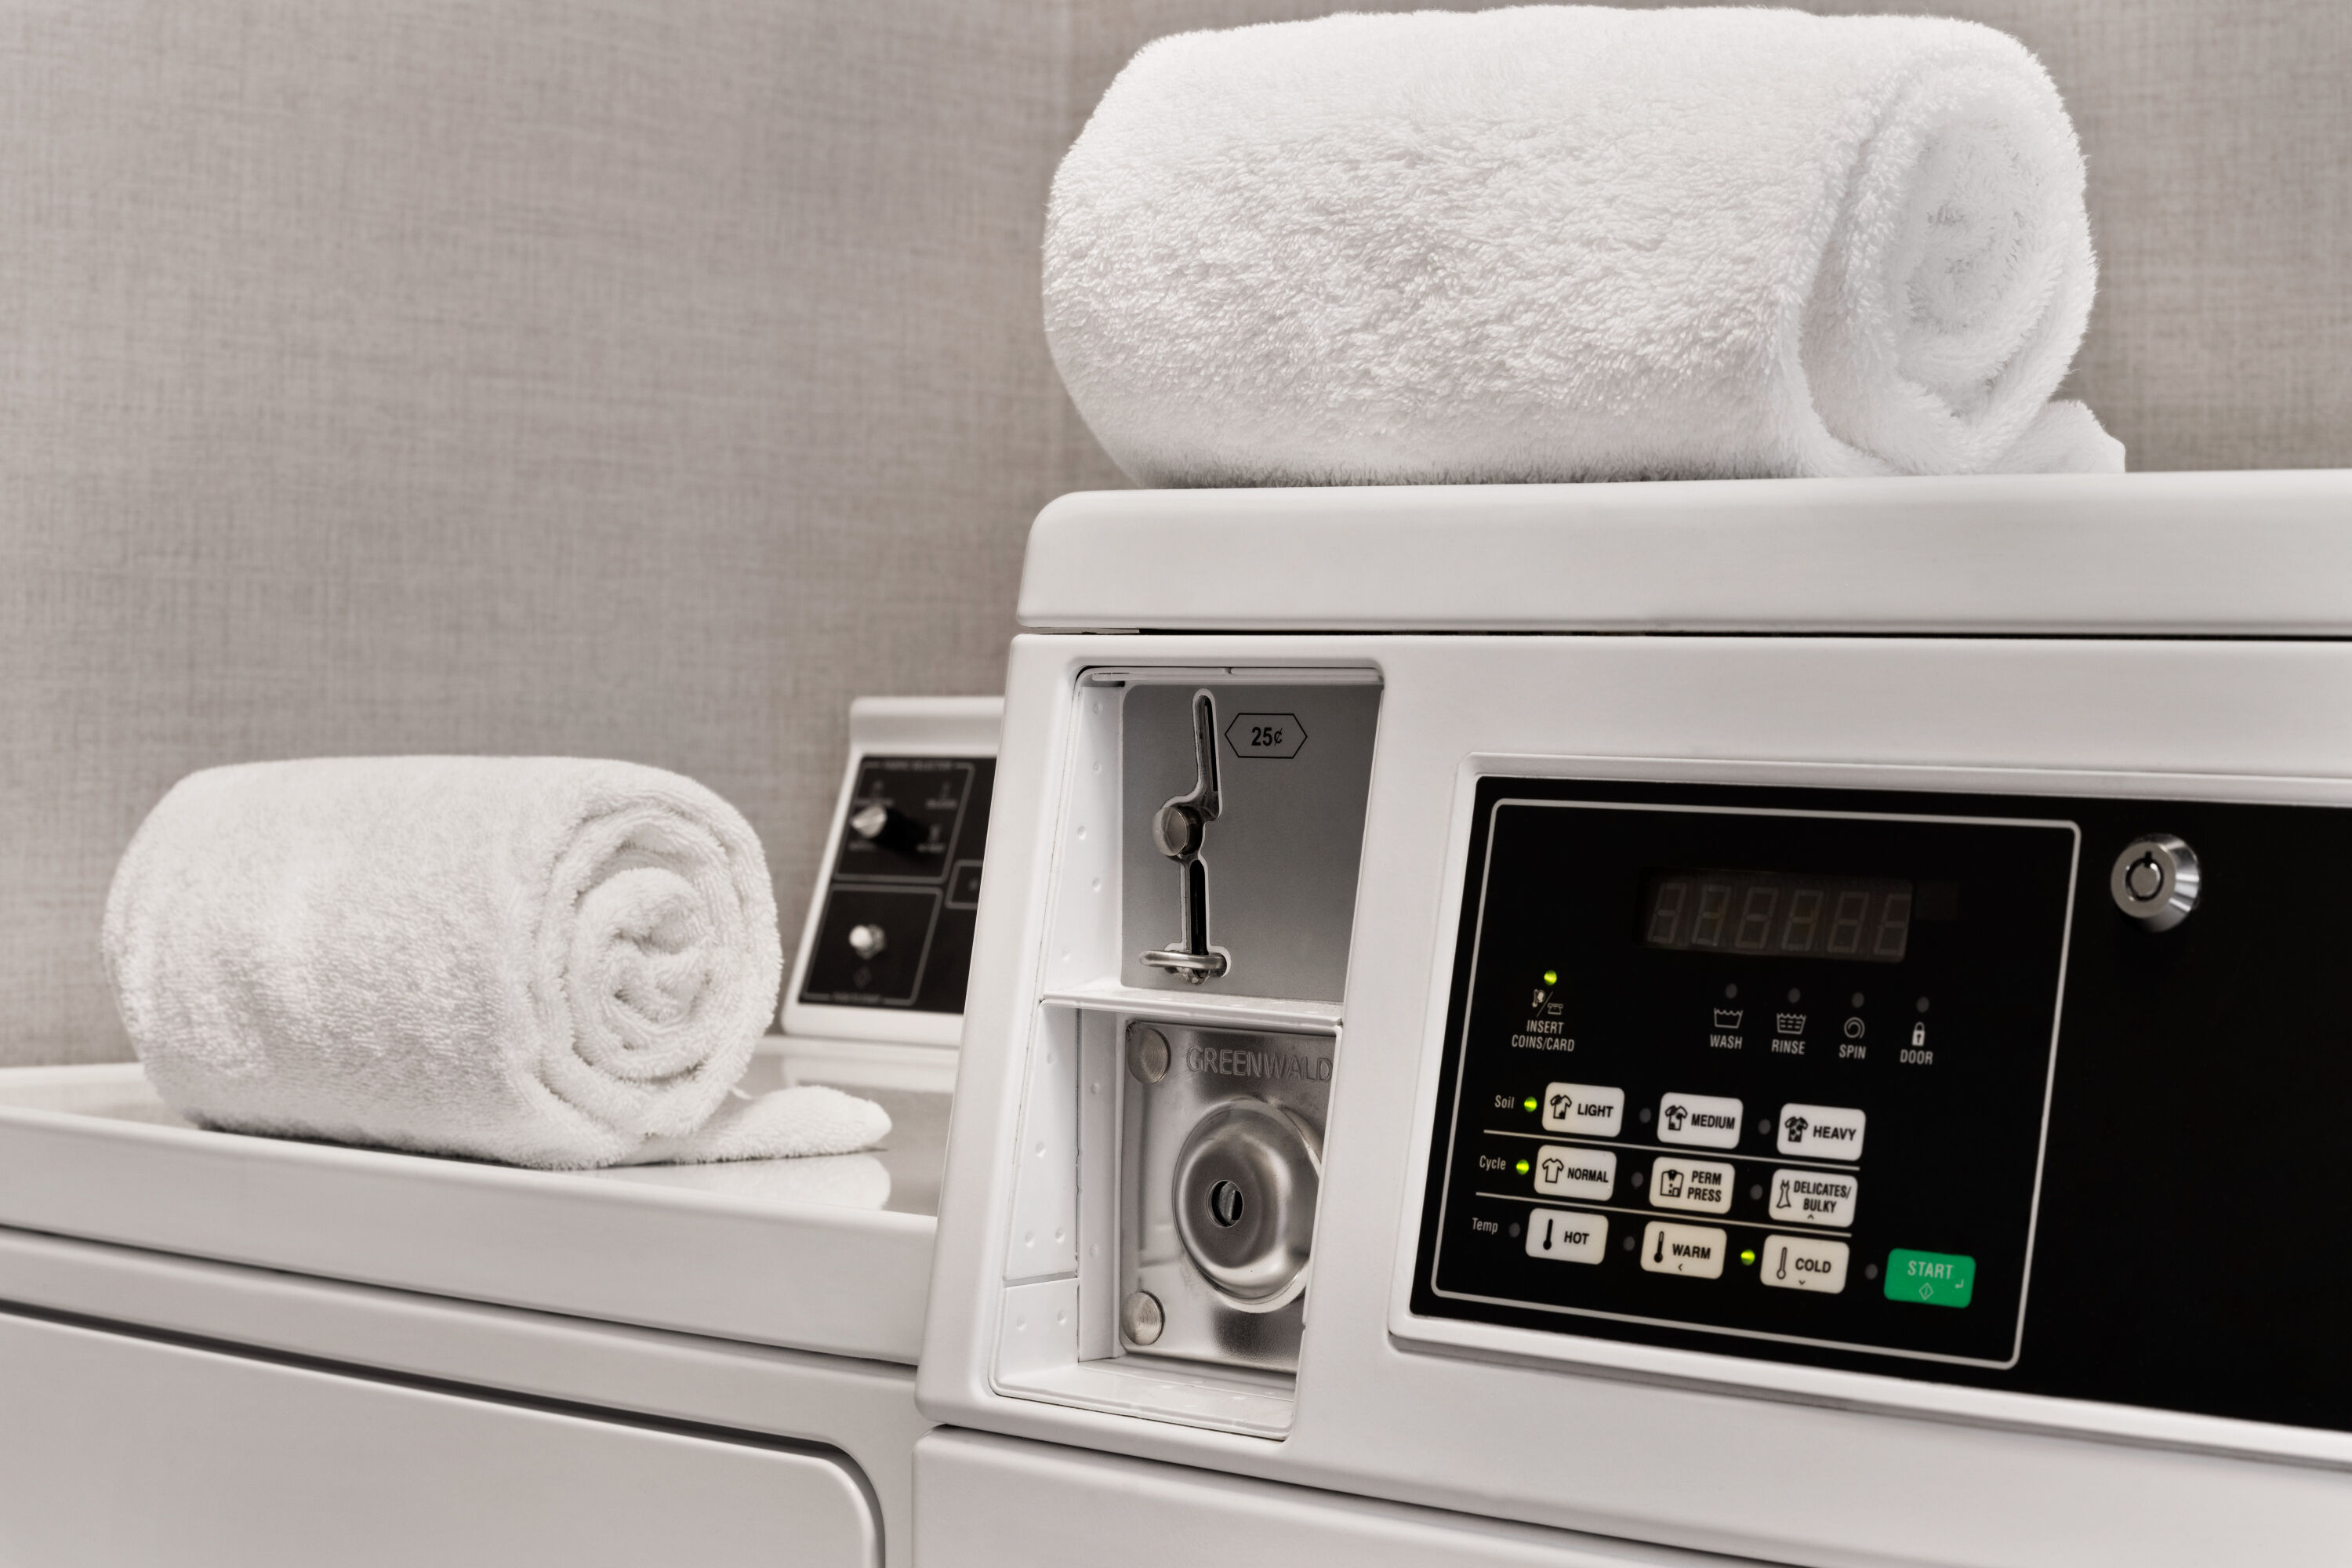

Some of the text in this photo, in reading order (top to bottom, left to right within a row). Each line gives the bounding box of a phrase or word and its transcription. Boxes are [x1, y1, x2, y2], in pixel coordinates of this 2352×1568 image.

[1251, 727, 1283, 746] 25¢
[1526, 1019, 1565, 1034] INSERT
[1511, 1034, 1575, 1052] COINS/CARD
[1711, 1035, 1742, 1049] WASH
[1772, 1040, 1805, 1054] RINSE
[1839, 1044, 1866, 1058] SPIN
[1900, 1049, 1933, 1065] DOOR
[1186, 1045, 1334, 1083] GREENWALD
[1495, 1095, 1514, 1109] Soil
[1577, 1104, 1613, 1117] LIGHT
[1691, 1113, 1735, 1129] MEDIUM
[1813, 1126, 1857, 1141] HEAVY
[1479, 1156, 1506, 1171] Cycle
[1567, 1167, 1608, 1183] NORMAL
[1692, 1171, 1722, 1186] PERM
[1687, 1185, 1722, 1202] PRESS
[1793, 1180, 1852, 1199] DELICATES/
[1803, 1198, 1836, 1213] BULKY
[1472, 1218, 1497, 1234] Temp
[1564, 1231, 1589, 1244] HOT
[1672, 1243, 1711, 1259] WARM
[1795, 1258, 1831, 1273] COLD
[1907, 1261, 1953, 1279] START
